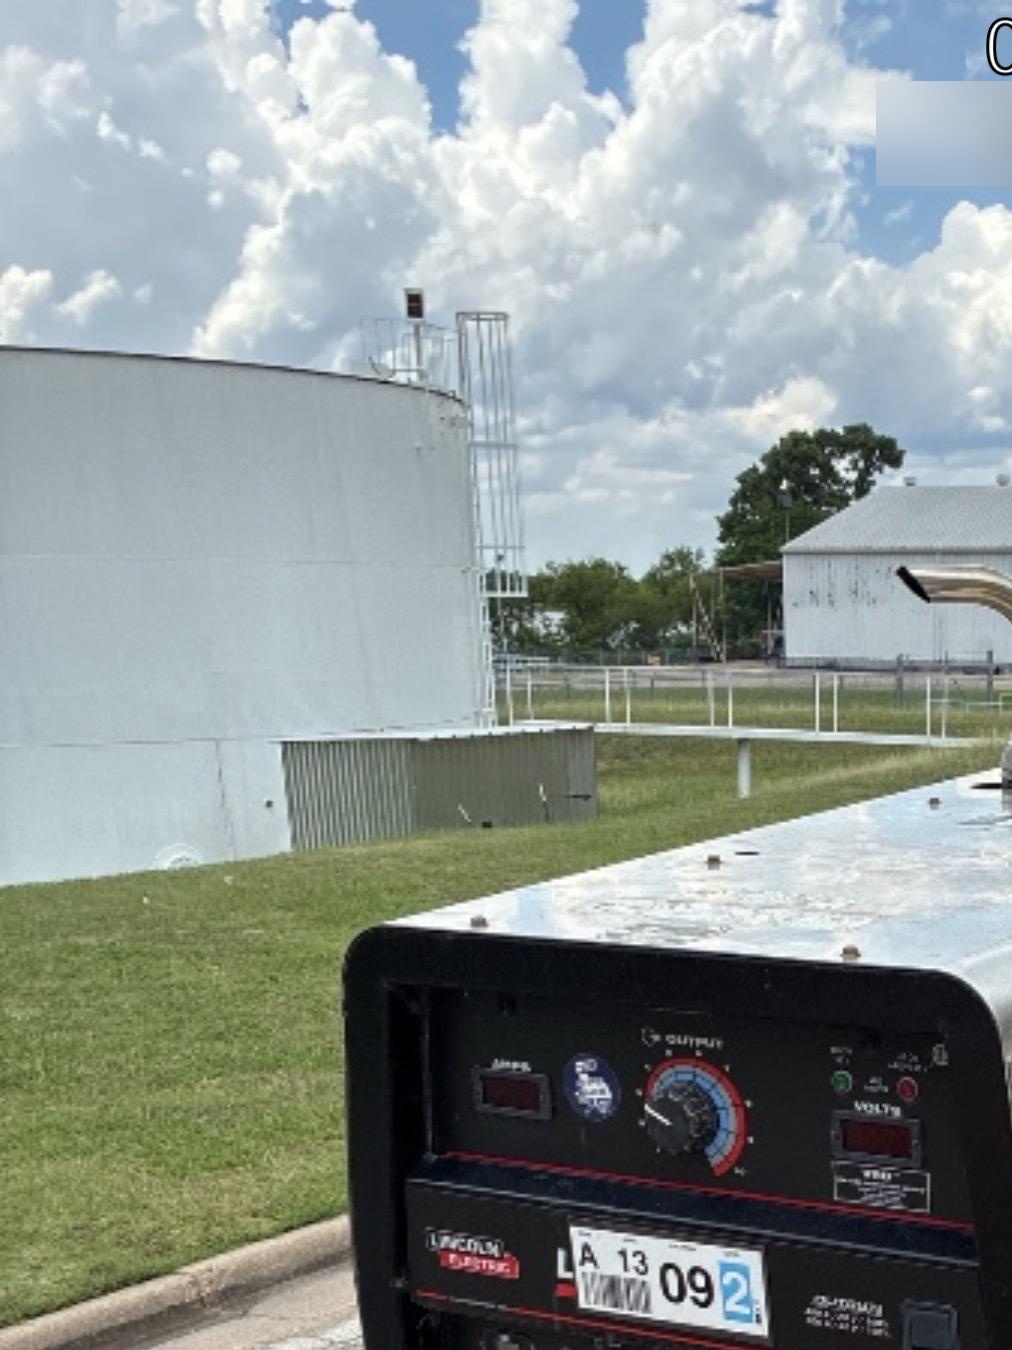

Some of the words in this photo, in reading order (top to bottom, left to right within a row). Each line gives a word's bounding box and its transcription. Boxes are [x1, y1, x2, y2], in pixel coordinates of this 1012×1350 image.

[854, 1101, 901, 1117] VOLTS
[431, 1232, 500, 1257] LINCOLN
[579, 1242, 600, 1269] A
[617, 1248, 648, 1275] 13
